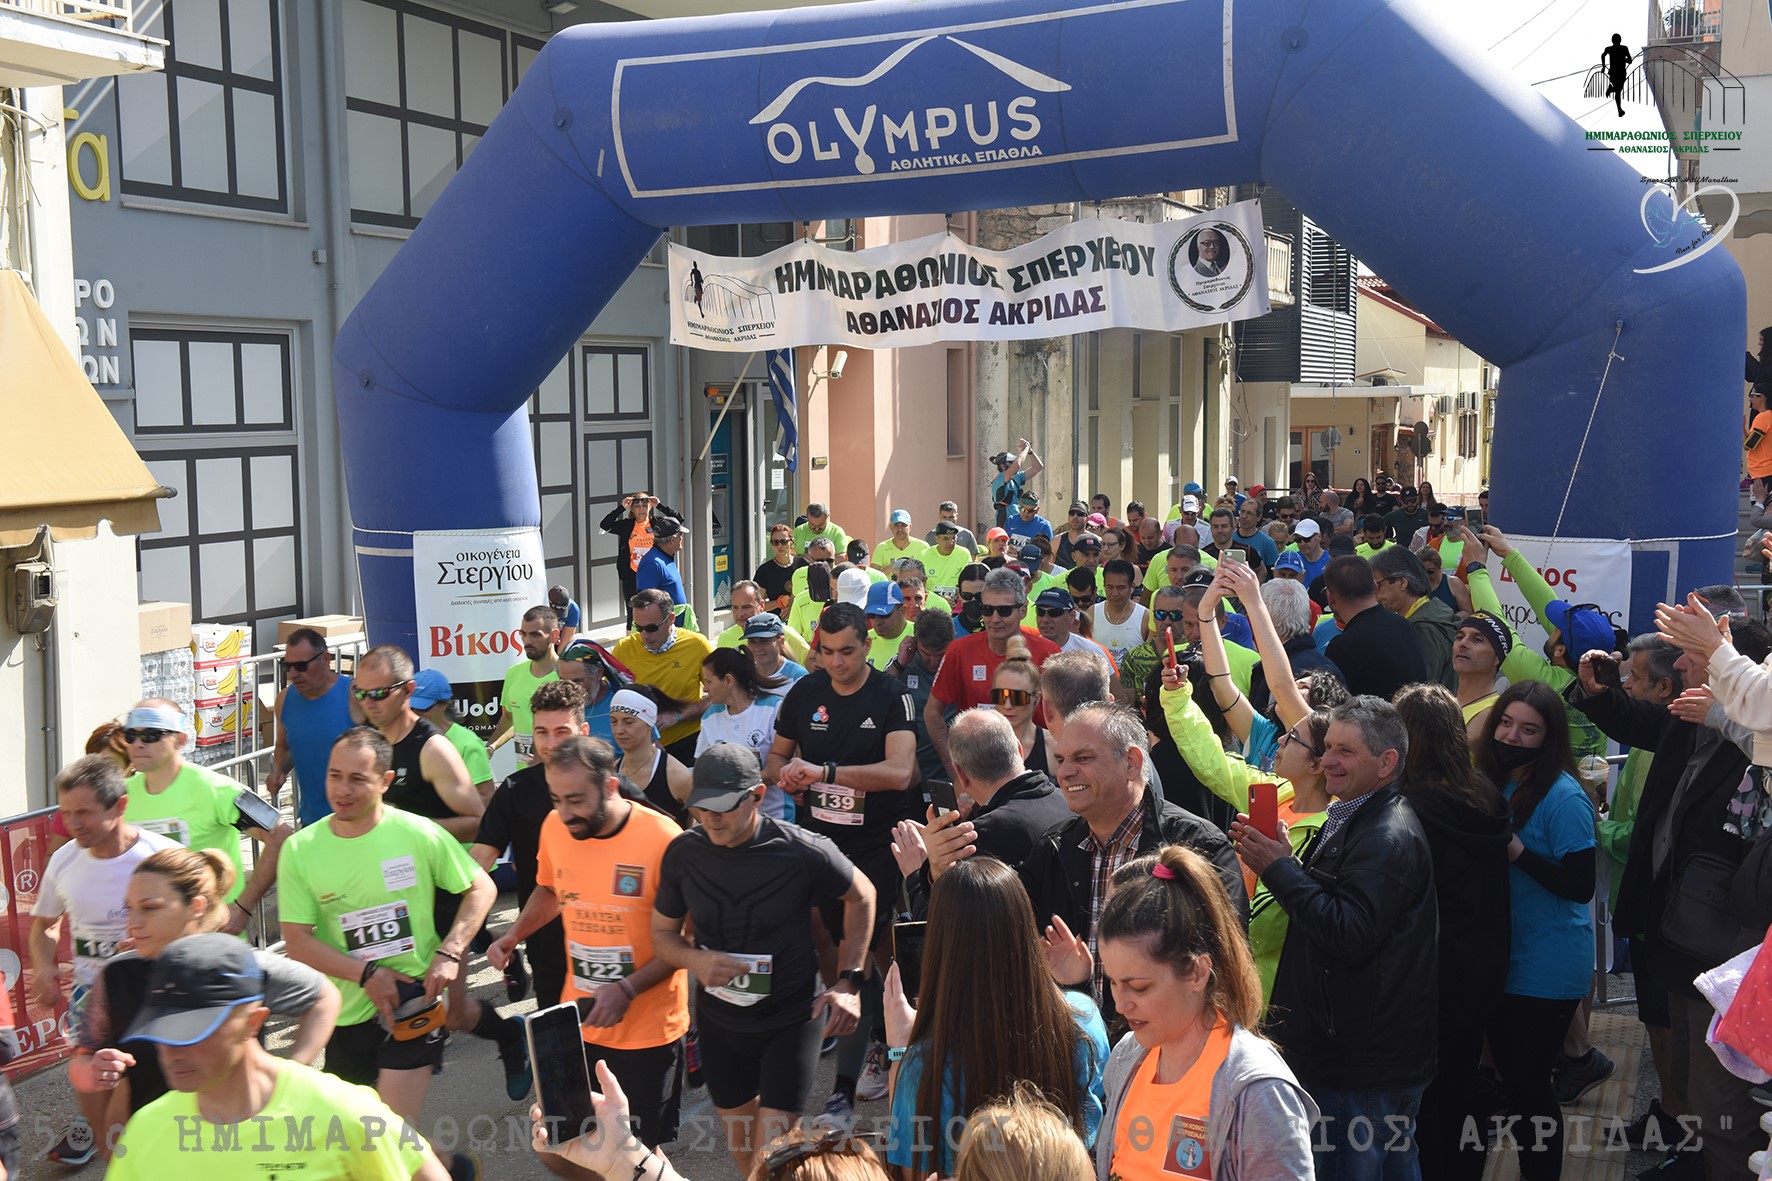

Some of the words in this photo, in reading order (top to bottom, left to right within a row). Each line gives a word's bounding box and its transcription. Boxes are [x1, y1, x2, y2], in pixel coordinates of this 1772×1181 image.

[767, 96, 1041, 174] OLYMPUS
[890, 152, 972, 171] ΑΘΛΗΤΙΚΑ
[975, 145, 1043, 163] ΕΠΑΘΛΑ
[775, 252, 1004, 300] ΗΜΙΜΑΡΑΘΩΝΙΟΣ
[1007, 236, 1155, 293] ΣΠΕΡΧΕΙΟΥ
[74, 278, 115, 309] ΡΟ
[846, 297, 980, 336] ΑΘΑΝΑΣΙΟΣ
[988, 285, 1107, 326] ΑΚΡΙΔΑΣ
[82, 354, 120, 384] ΩΝ
[456, 548, 521, 564] οικογένεια
[437, 560, 533, 591] Στεργίου
[430, 623, 523, 657] Βίκος
[818, 793, 855, 810] 139
[353, 920, 401, 945] 119
[578, 961, 624, 979] 122
